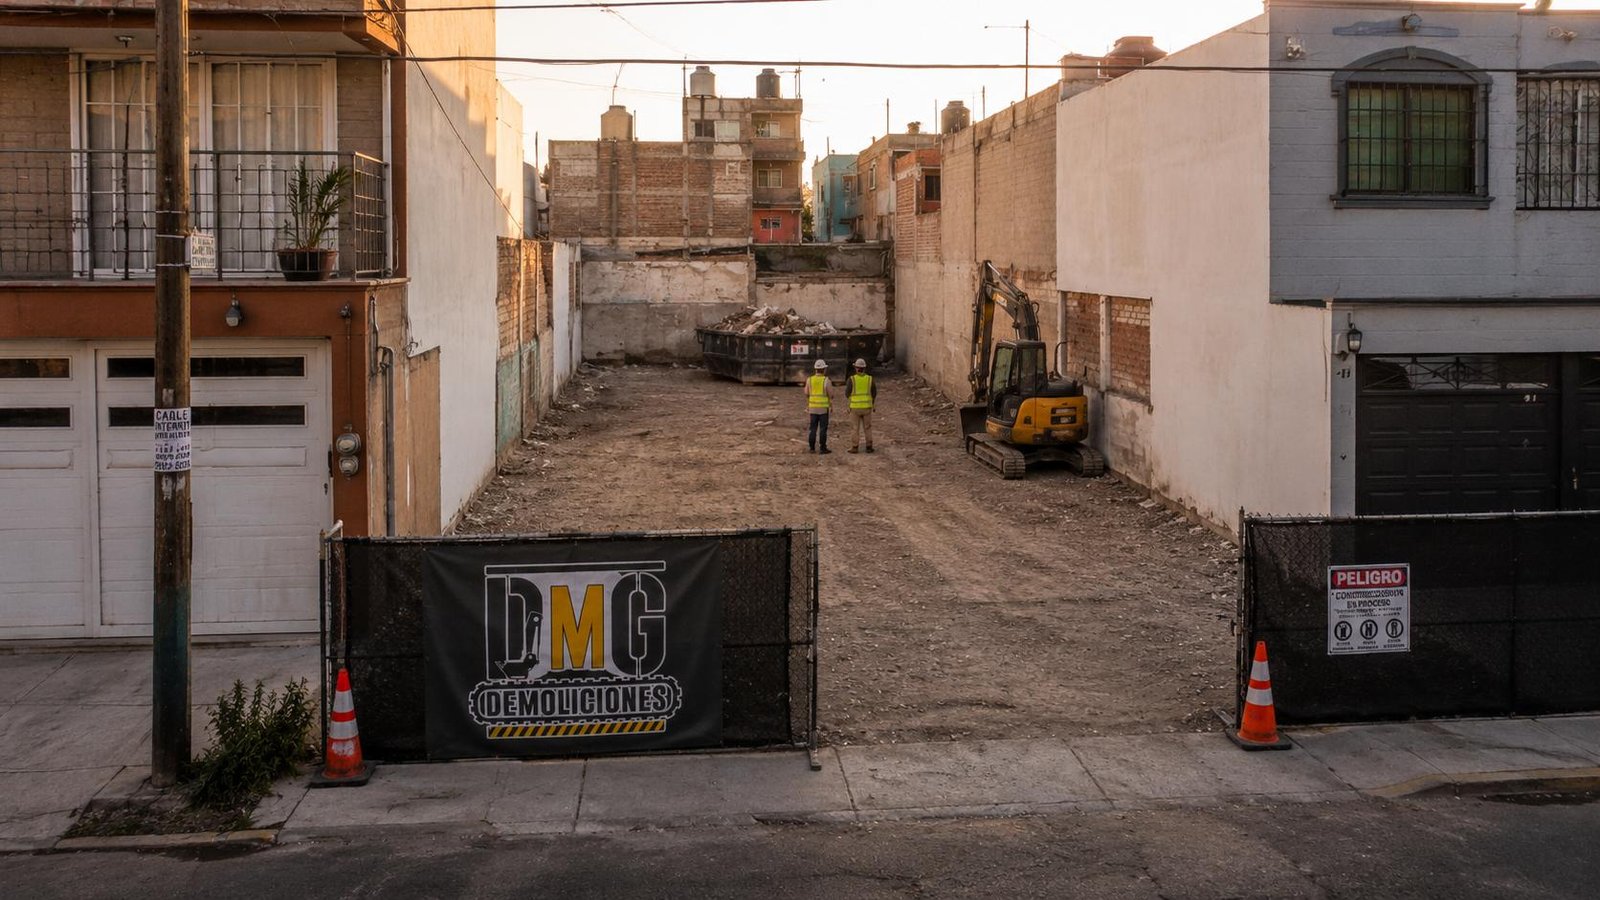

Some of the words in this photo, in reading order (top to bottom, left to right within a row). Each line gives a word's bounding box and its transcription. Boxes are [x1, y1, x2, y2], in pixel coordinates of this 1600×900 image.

[1337, 570, 1402, 585] PELIGRO
[485, 571, 666, 680] DMG
[486, 684, 668, 717] DEMOLICIONES
